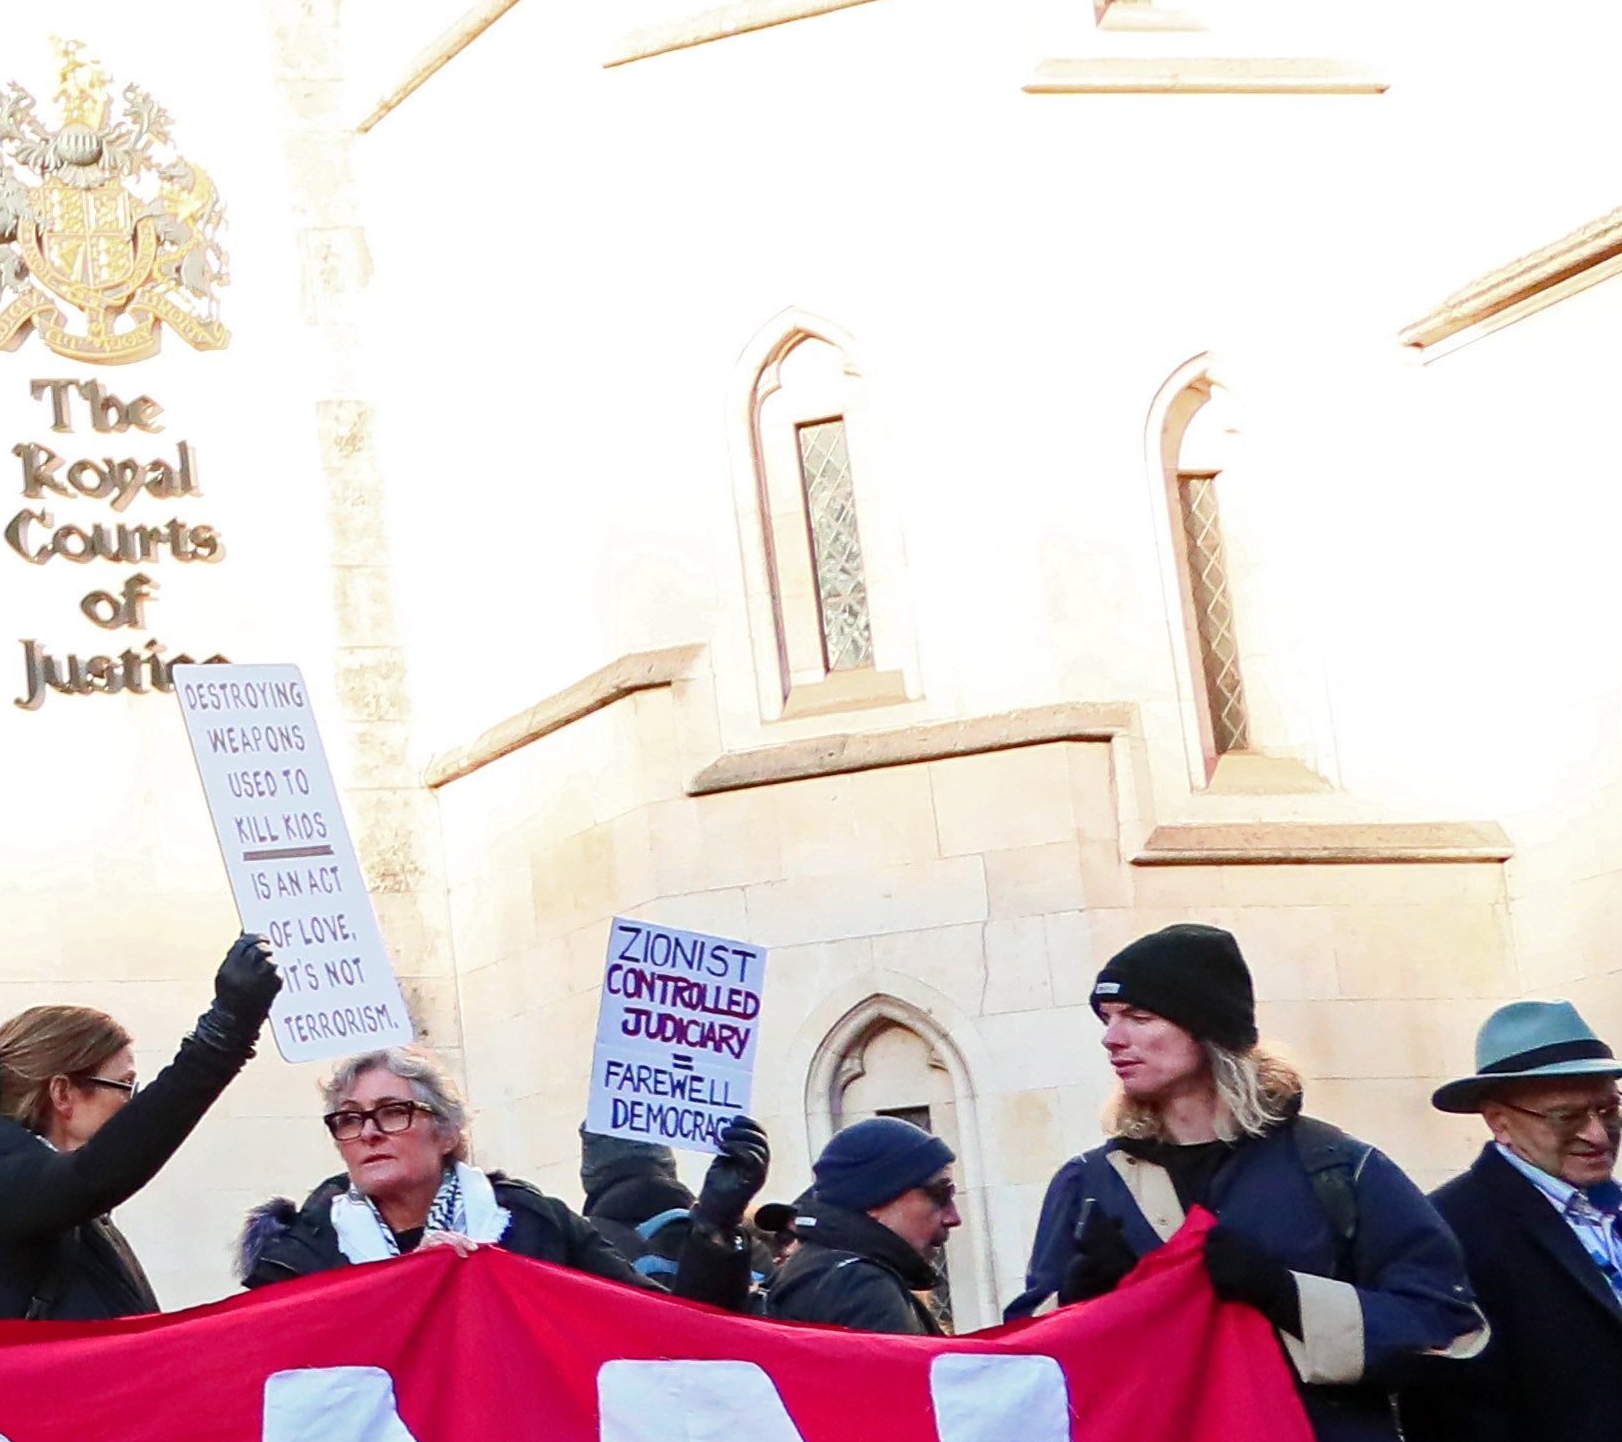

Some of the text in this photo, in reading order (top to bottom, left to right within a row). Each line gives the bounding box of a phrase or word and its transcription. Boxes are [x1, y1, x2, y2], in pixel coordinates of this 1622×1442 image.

[30, 378, 165, 433] The
[11, 440, 204, 513] Royal
[4, 507, 225, 565] Courts
[80, 572, 161, 630] of
[13, 638, 233, 711] Justi
[185, 682, 304, 710] DESTROYING
[207, 725, 305, 753] WEAPONS
[227, 768, 309, 798] USED TO
[235, 812, 327, 843] KILL KIDS
[251, 866, 343, 900] IS AN ACT
[269, 914, 357, 948] OF LOVE,
[618, 925, 757, 983] ZIONIST
[283, 957, 365, 994] IT'S NOT
[607, 963, 760, 1021] CONTROLLED
[284, 1004, 399, 1043] TERRORISM.
[621, 1006, 751, 1059] JUDICIARY
[604, 1060, 742, 1109] FAREWELL
[611, 1098, 734, 1146] DEMOCRAC
